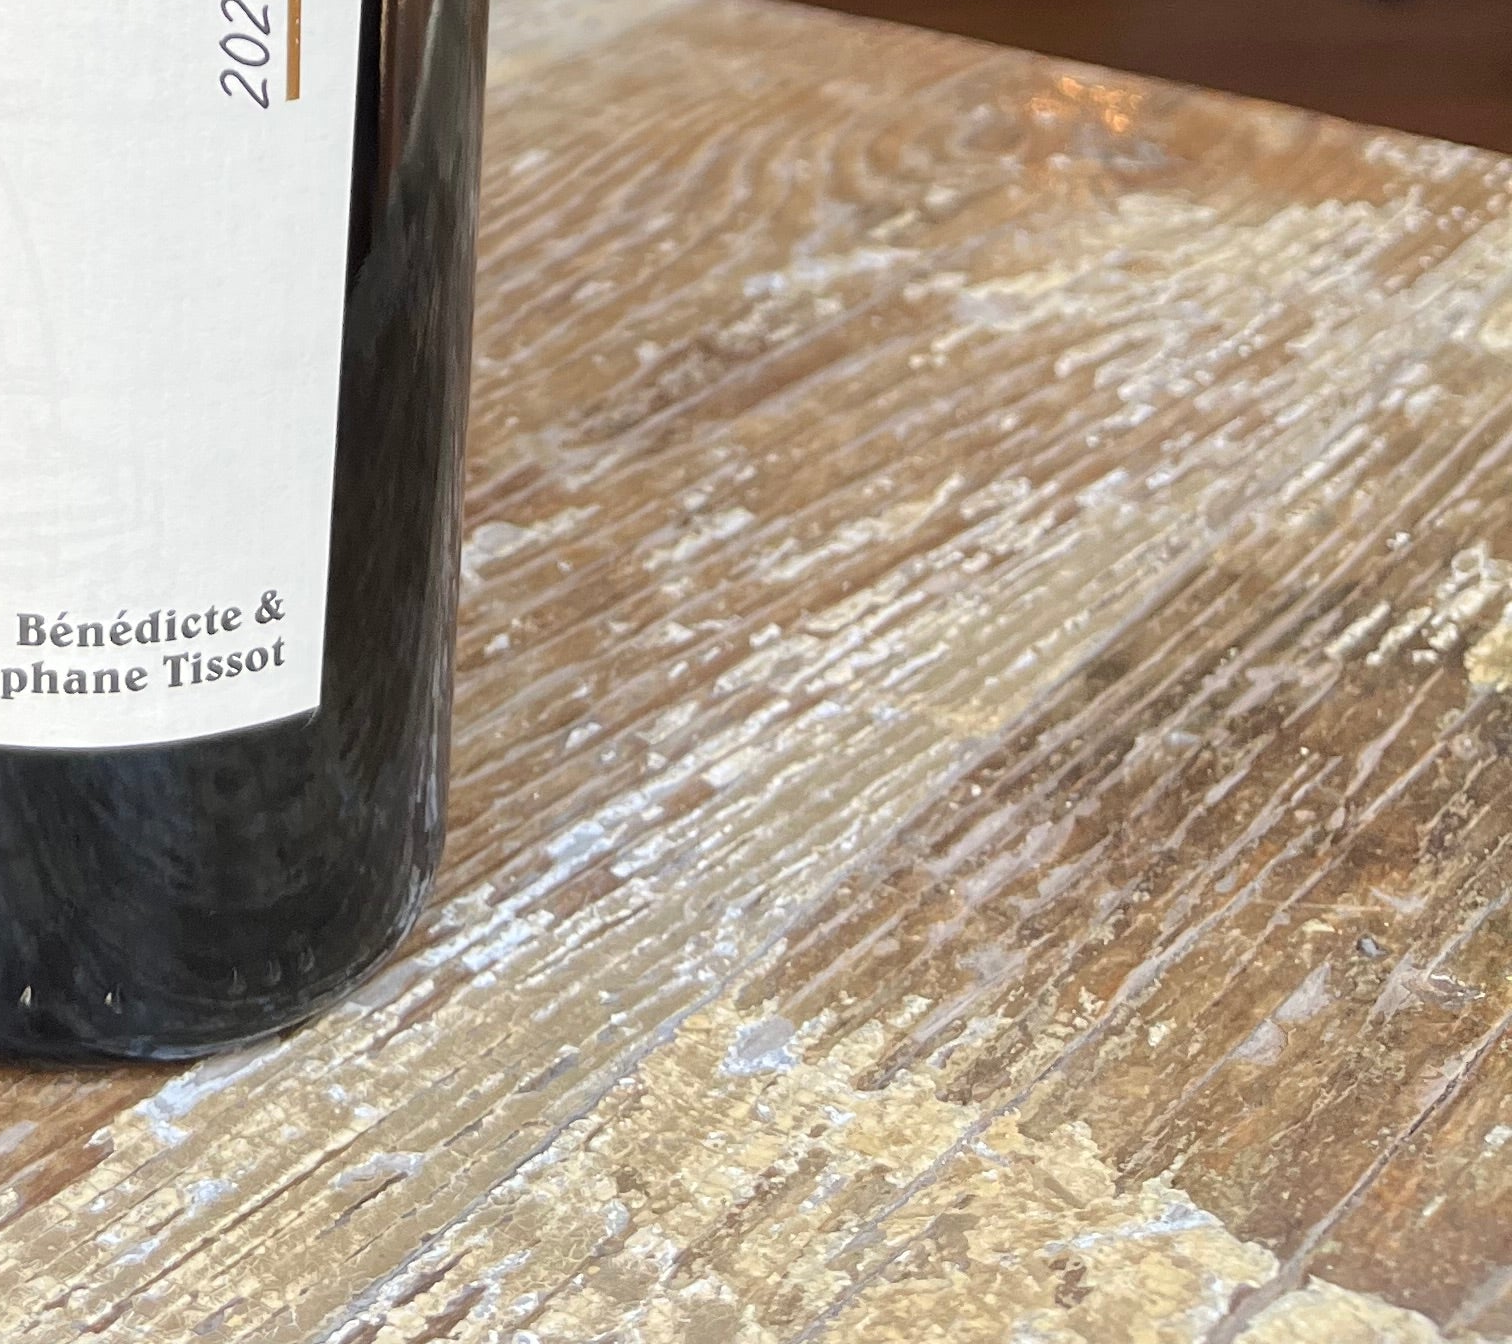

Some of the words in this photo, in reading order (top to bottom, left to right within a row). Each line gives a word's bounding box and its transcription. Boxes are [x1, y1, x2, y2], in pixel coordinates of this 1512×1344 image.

[16, 601, 243, 648] Bénédicte
[253, 588, 287, 624] &
[161, 636, 287, 689] Tissot
